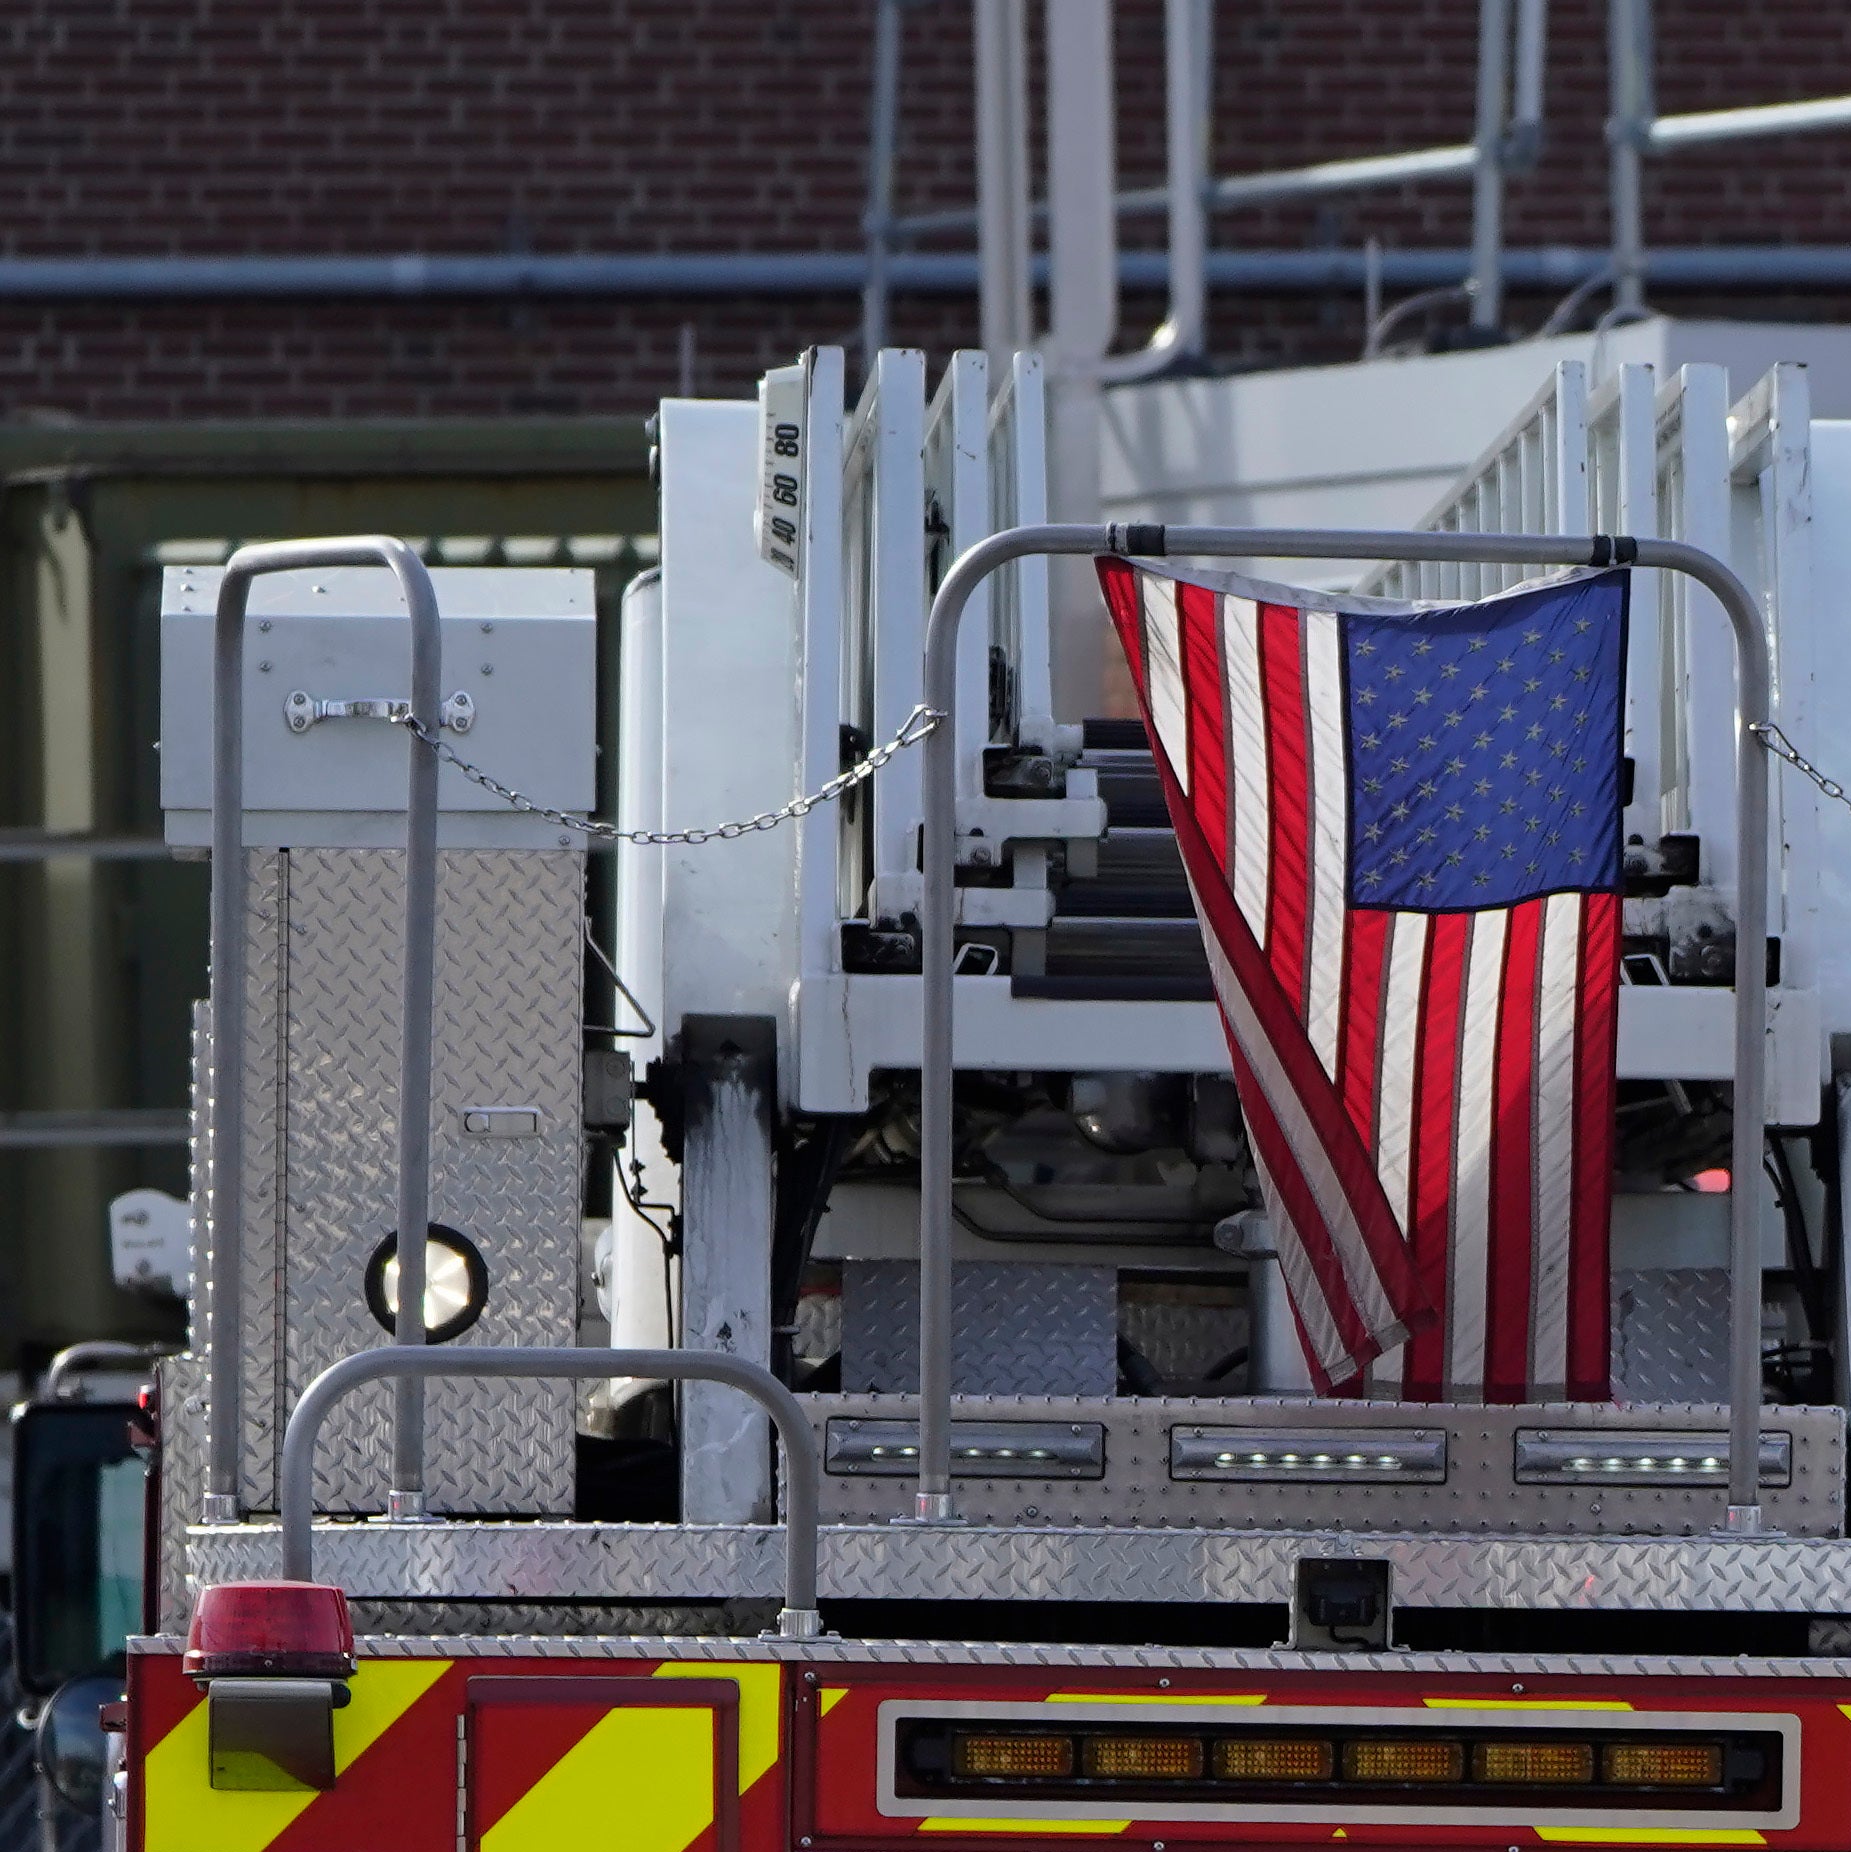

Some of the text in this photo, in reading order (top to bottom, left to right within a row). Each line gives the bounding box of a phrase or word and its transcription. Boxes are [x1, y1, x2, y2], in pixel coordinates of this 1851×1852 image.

[774, 423, 800, 457] 80
[773, 473, 798, 507] 60
[771, 515, 796, 545] 40
